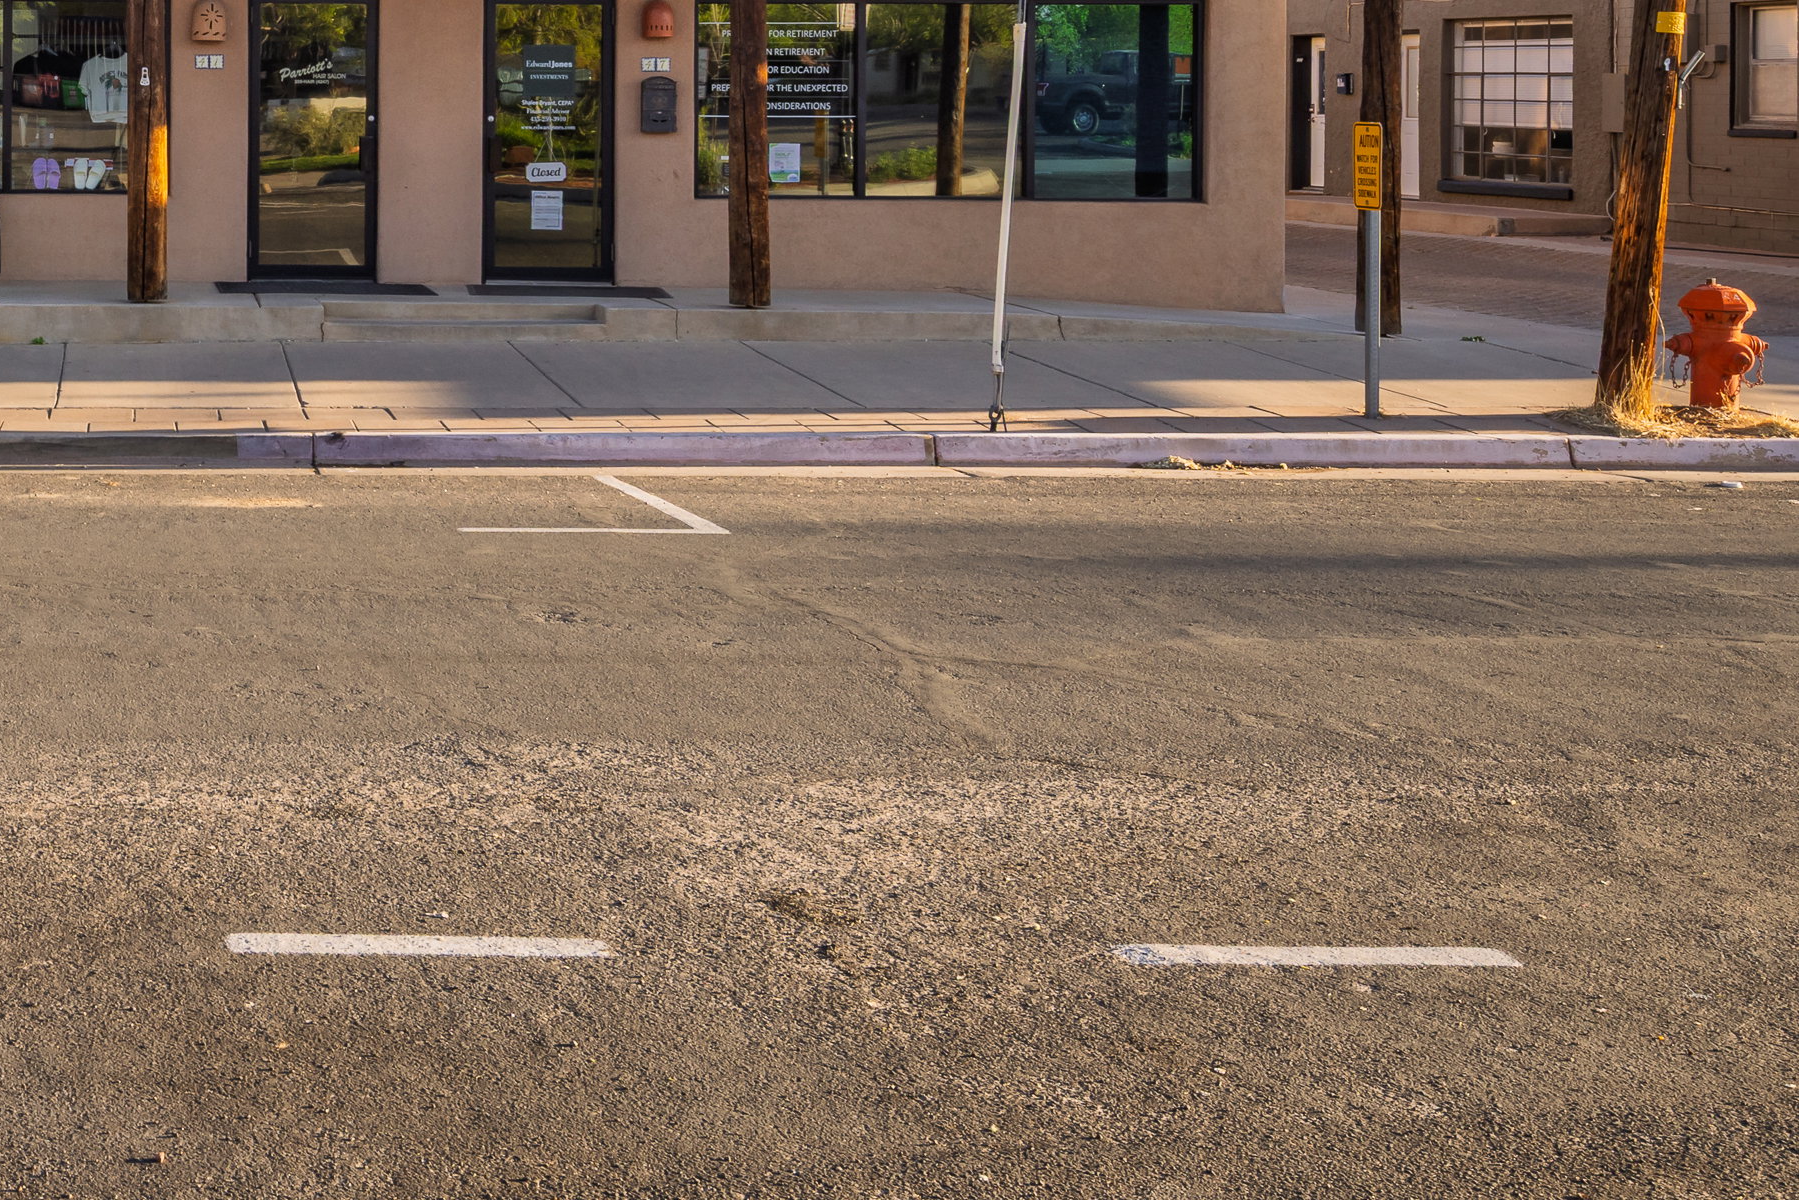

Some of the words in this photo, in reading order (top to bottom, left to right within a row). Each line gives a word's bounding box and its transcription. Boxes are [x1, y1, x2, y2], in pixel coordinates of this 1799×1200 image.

[768, 29, 785, 38] FOR
[786, 29, 838, 38] RETIREMENT
[774, 48, 826, 56] RETIREMENT
[279, 58, 334, 82] Parriott's
[767, 66, 779, 74] OR
[780, 66, 830, 74] EDUCATION
[776, 84, 793, 92] THE
[793, 84, 849, 93] UNEXPECTED
[766, 102, 831, 110] ONSIDERATIONS
[1356, 154, 1369, 163] WATCH
[1369, 154, 1378, 164] FOR
[531, 167, 562, 178] Closed
[1357, 166, 1377, 175] VEHICLES
[1357, 178, 1377, 187] CROSSING
[1357, 189, 1377, 199] SIDEWALK
